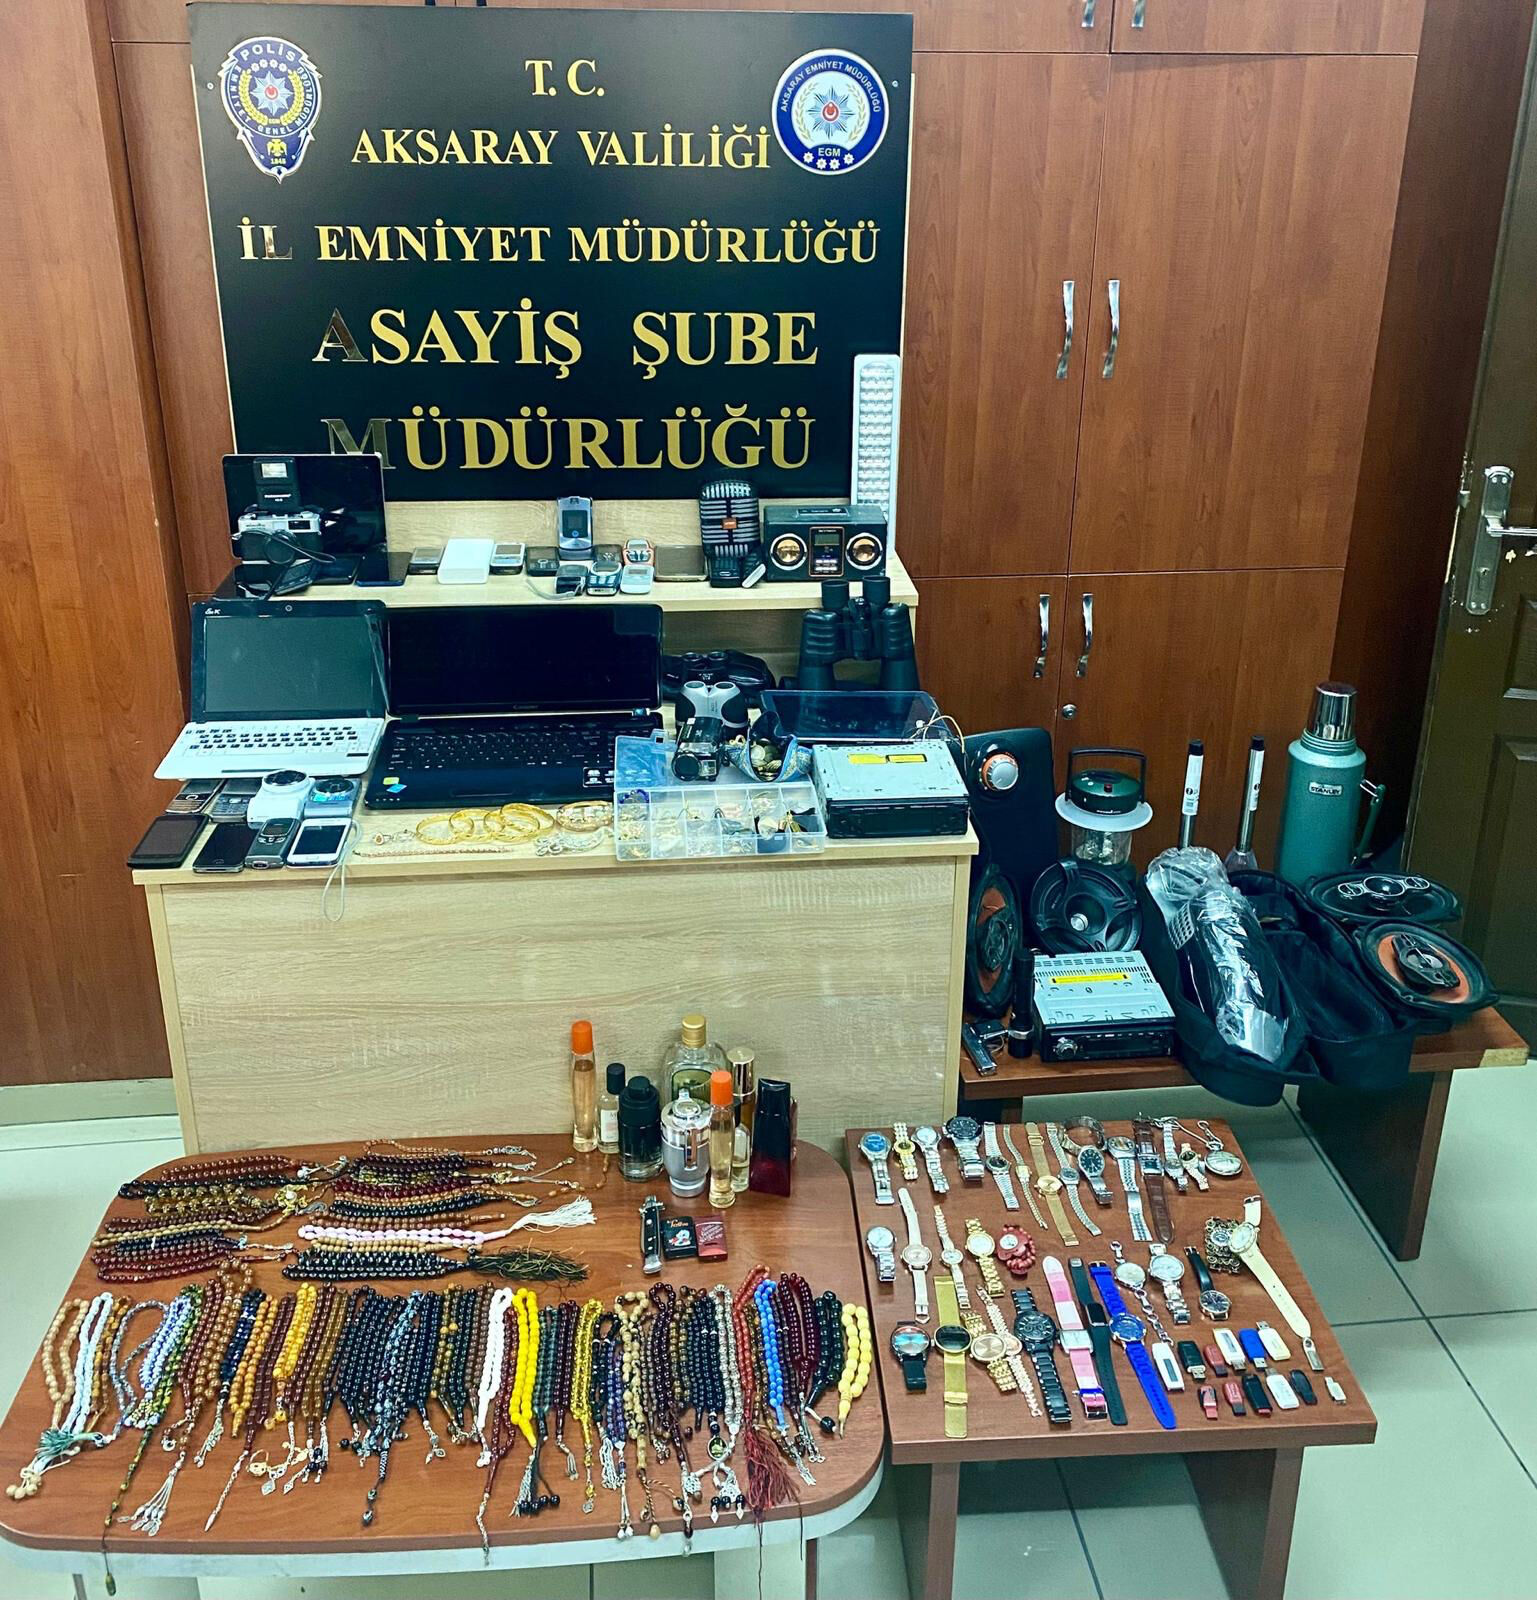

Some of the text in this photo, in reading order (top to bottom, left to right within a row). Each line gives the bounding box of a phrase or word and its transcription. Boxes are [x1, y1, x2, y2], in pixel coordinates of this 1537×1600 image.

[240, 43, 296, 61] POLİS
[781, 60, 881, 113] AKSARAY EMNİYET MÜDÜRLÜĞÜ
[257, 125, 292, 135] GENEL
[352, 123, 770, 168] AKSARAY VALİLİĞİ
[818, 147, 840, 157] EGM
[237, 216, 880, 263] İL EMNİYET MÜDÜRLÜĞÜ
[312, 297, 819, 379] ASAYİŞ ŞUBE
[320, 403, 817, 470] MÜDÜRLÜĞÜ
